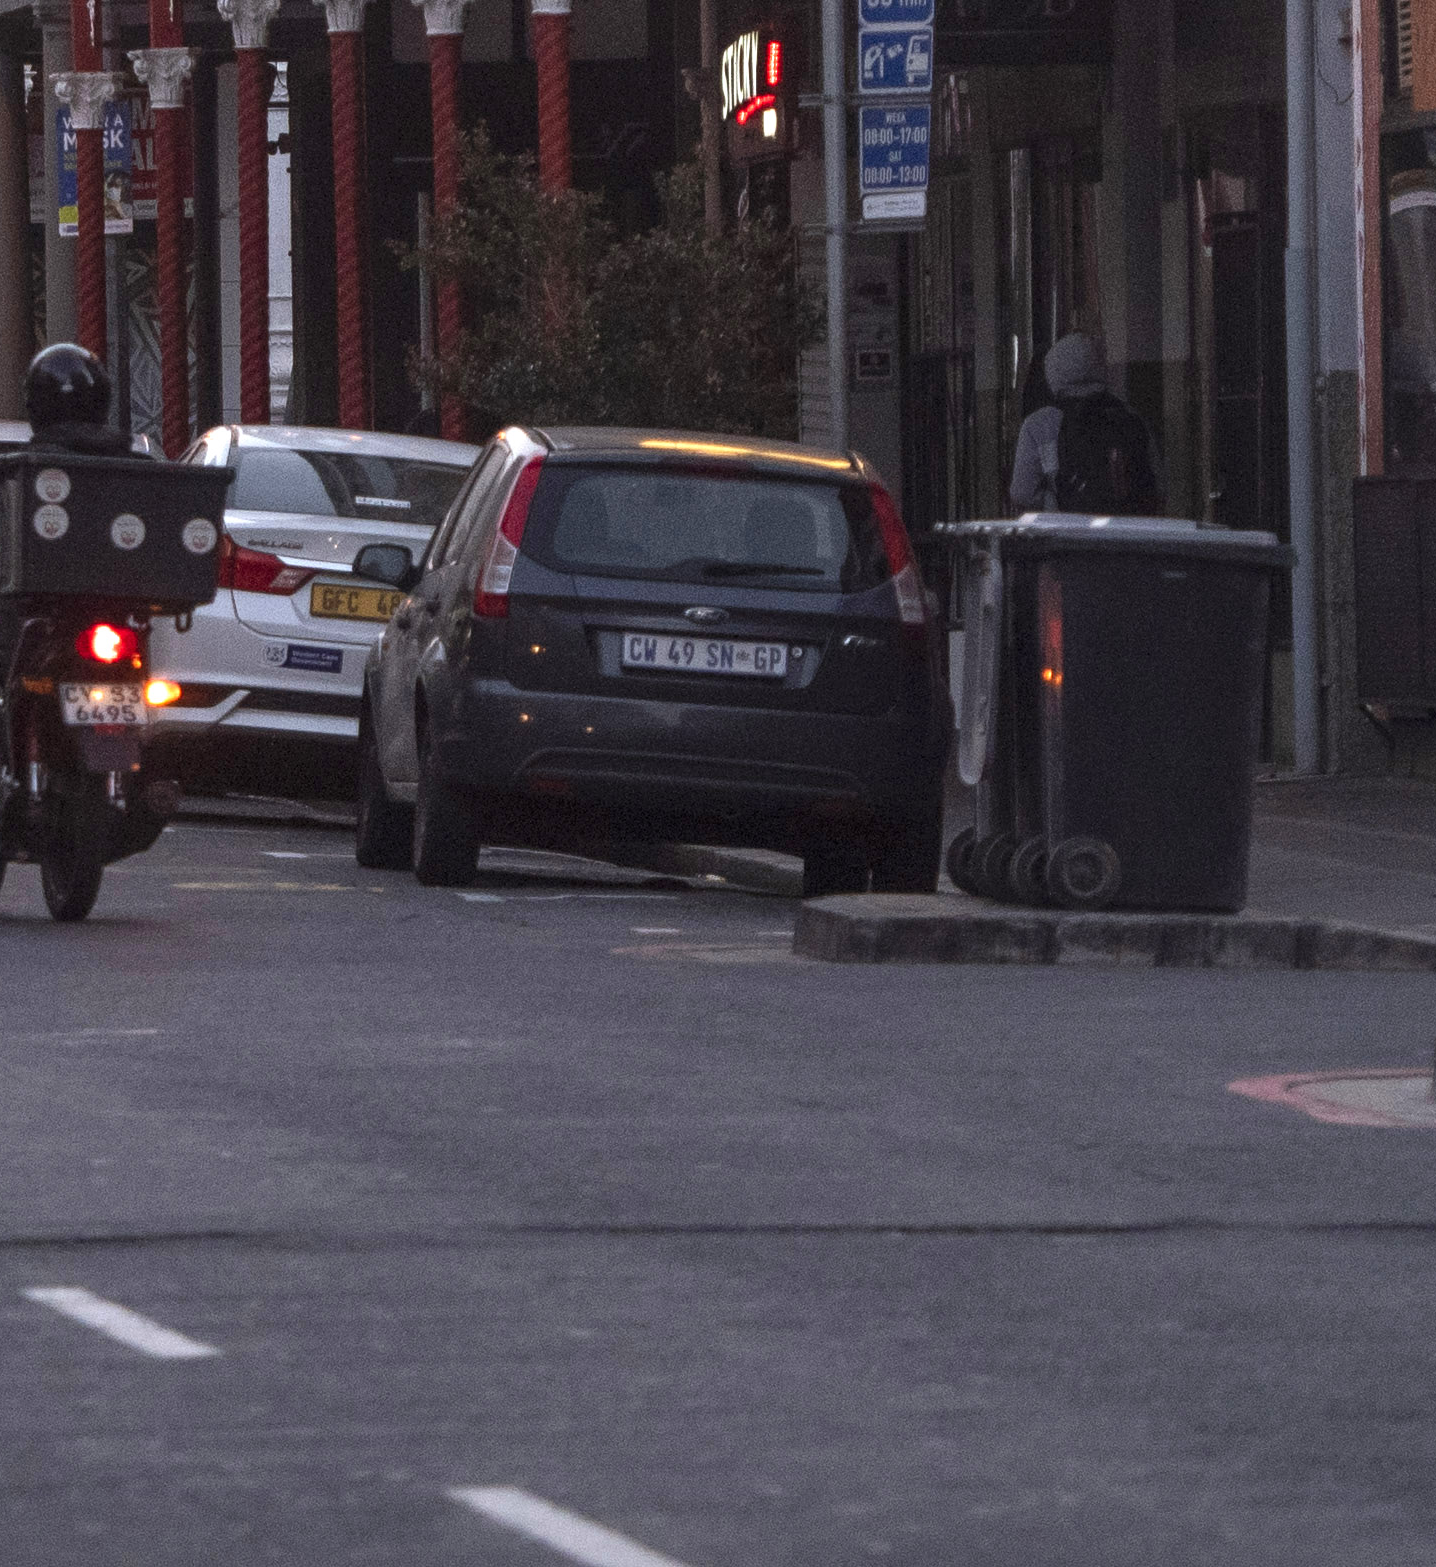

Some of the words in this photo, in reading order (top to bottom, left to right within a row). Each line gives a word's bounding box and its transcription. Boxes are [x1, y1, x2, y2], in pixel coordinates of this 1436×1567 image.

[722, 30, 759, 122] STICKY
[62, 128, 125, 152] MSK
[630, 636, 658, 663] CW
[668, 638, 696, 666] 49
[706, 641, 735, 670] SN
[753, 645, 783, 673] GP
[76, 704, 137, 722] 6495
